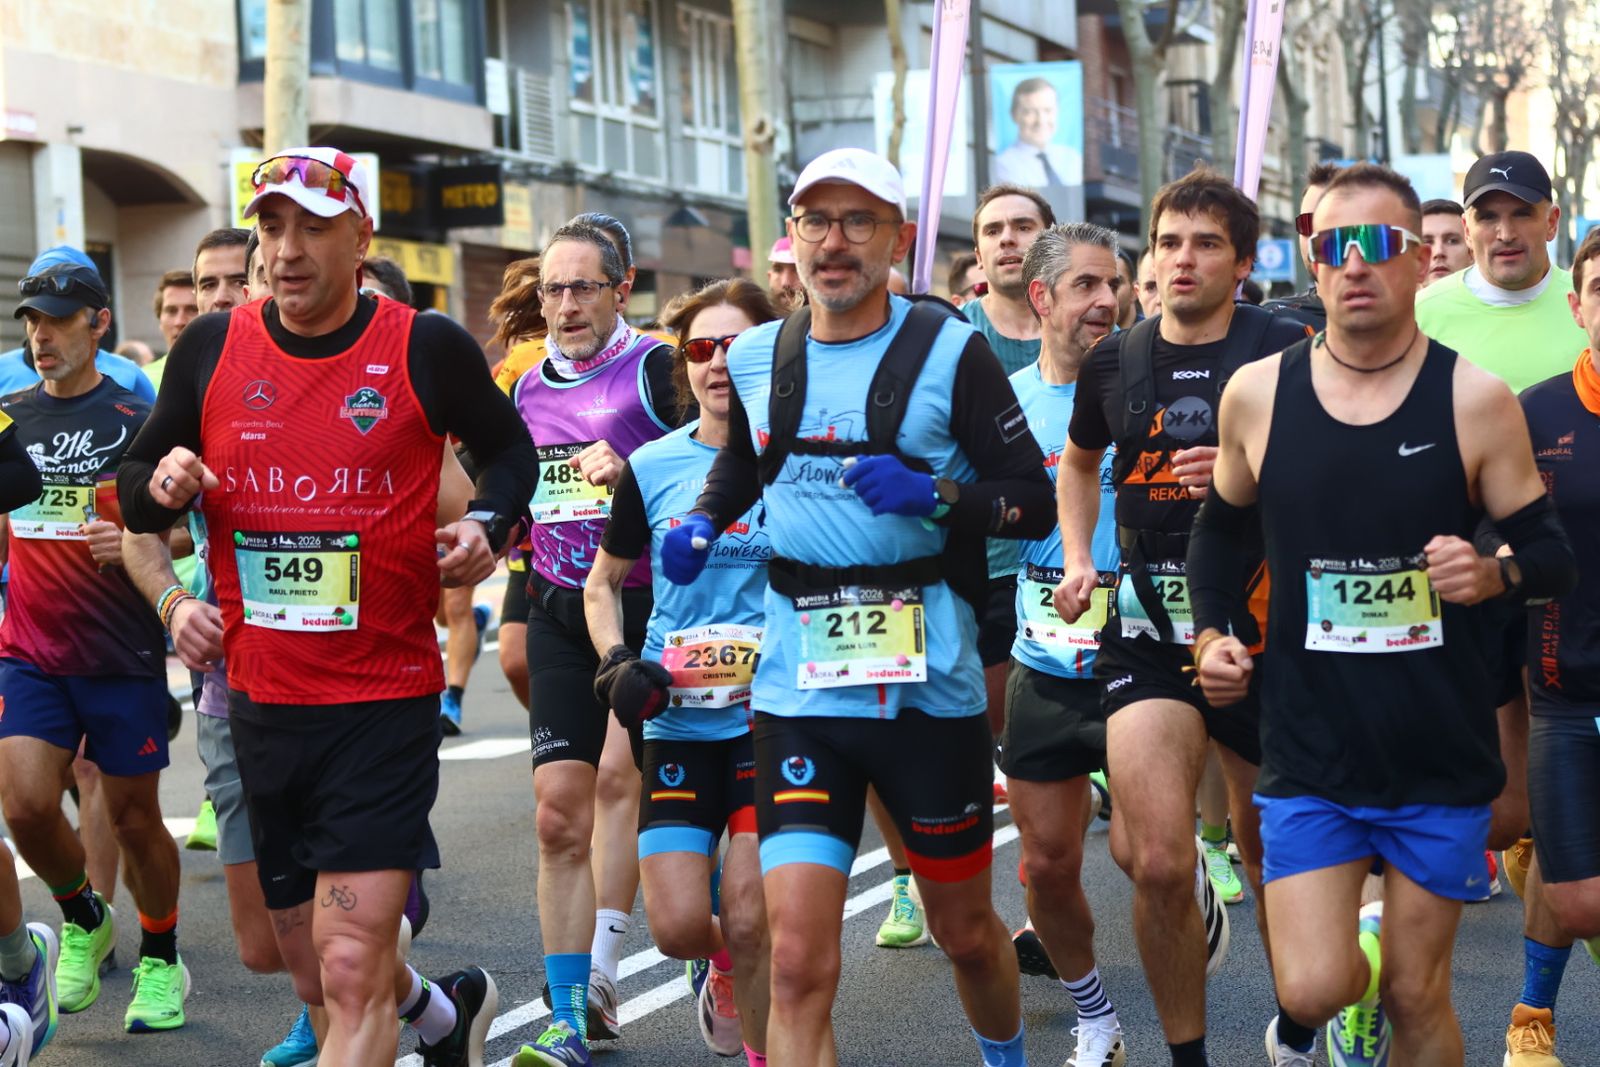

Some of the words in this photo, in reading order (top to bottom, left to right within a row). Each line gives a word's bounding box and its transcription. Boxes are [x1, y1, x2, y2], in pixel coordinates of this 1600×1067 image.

[240, 431, 266, 441] Adarsa
[1538, 447, 1573, 457] LABORAL
[225, 466, 394, 502] SABOREA
[1149, 487, 1203, 501] REKA
[297, 536, 321, 546] 2026
[264, 557, 323, 583] 549
[289, 588, 318, 597] PRIETO
[860, 589, 884, 600] 2026
[1333, 576, 1416, 605] 1244
[1361, 611, 1389, 619] DIMAS
[826, 610, 888, 638] 212
[683, 645, 755, 669] 2367
[702, 671, 737, 680] CRISTINA
[866, 669, 913, 679] bedunia
[1541, 657, 1562, 689] XIII
[537, 740, 569, 753] POPULARES
